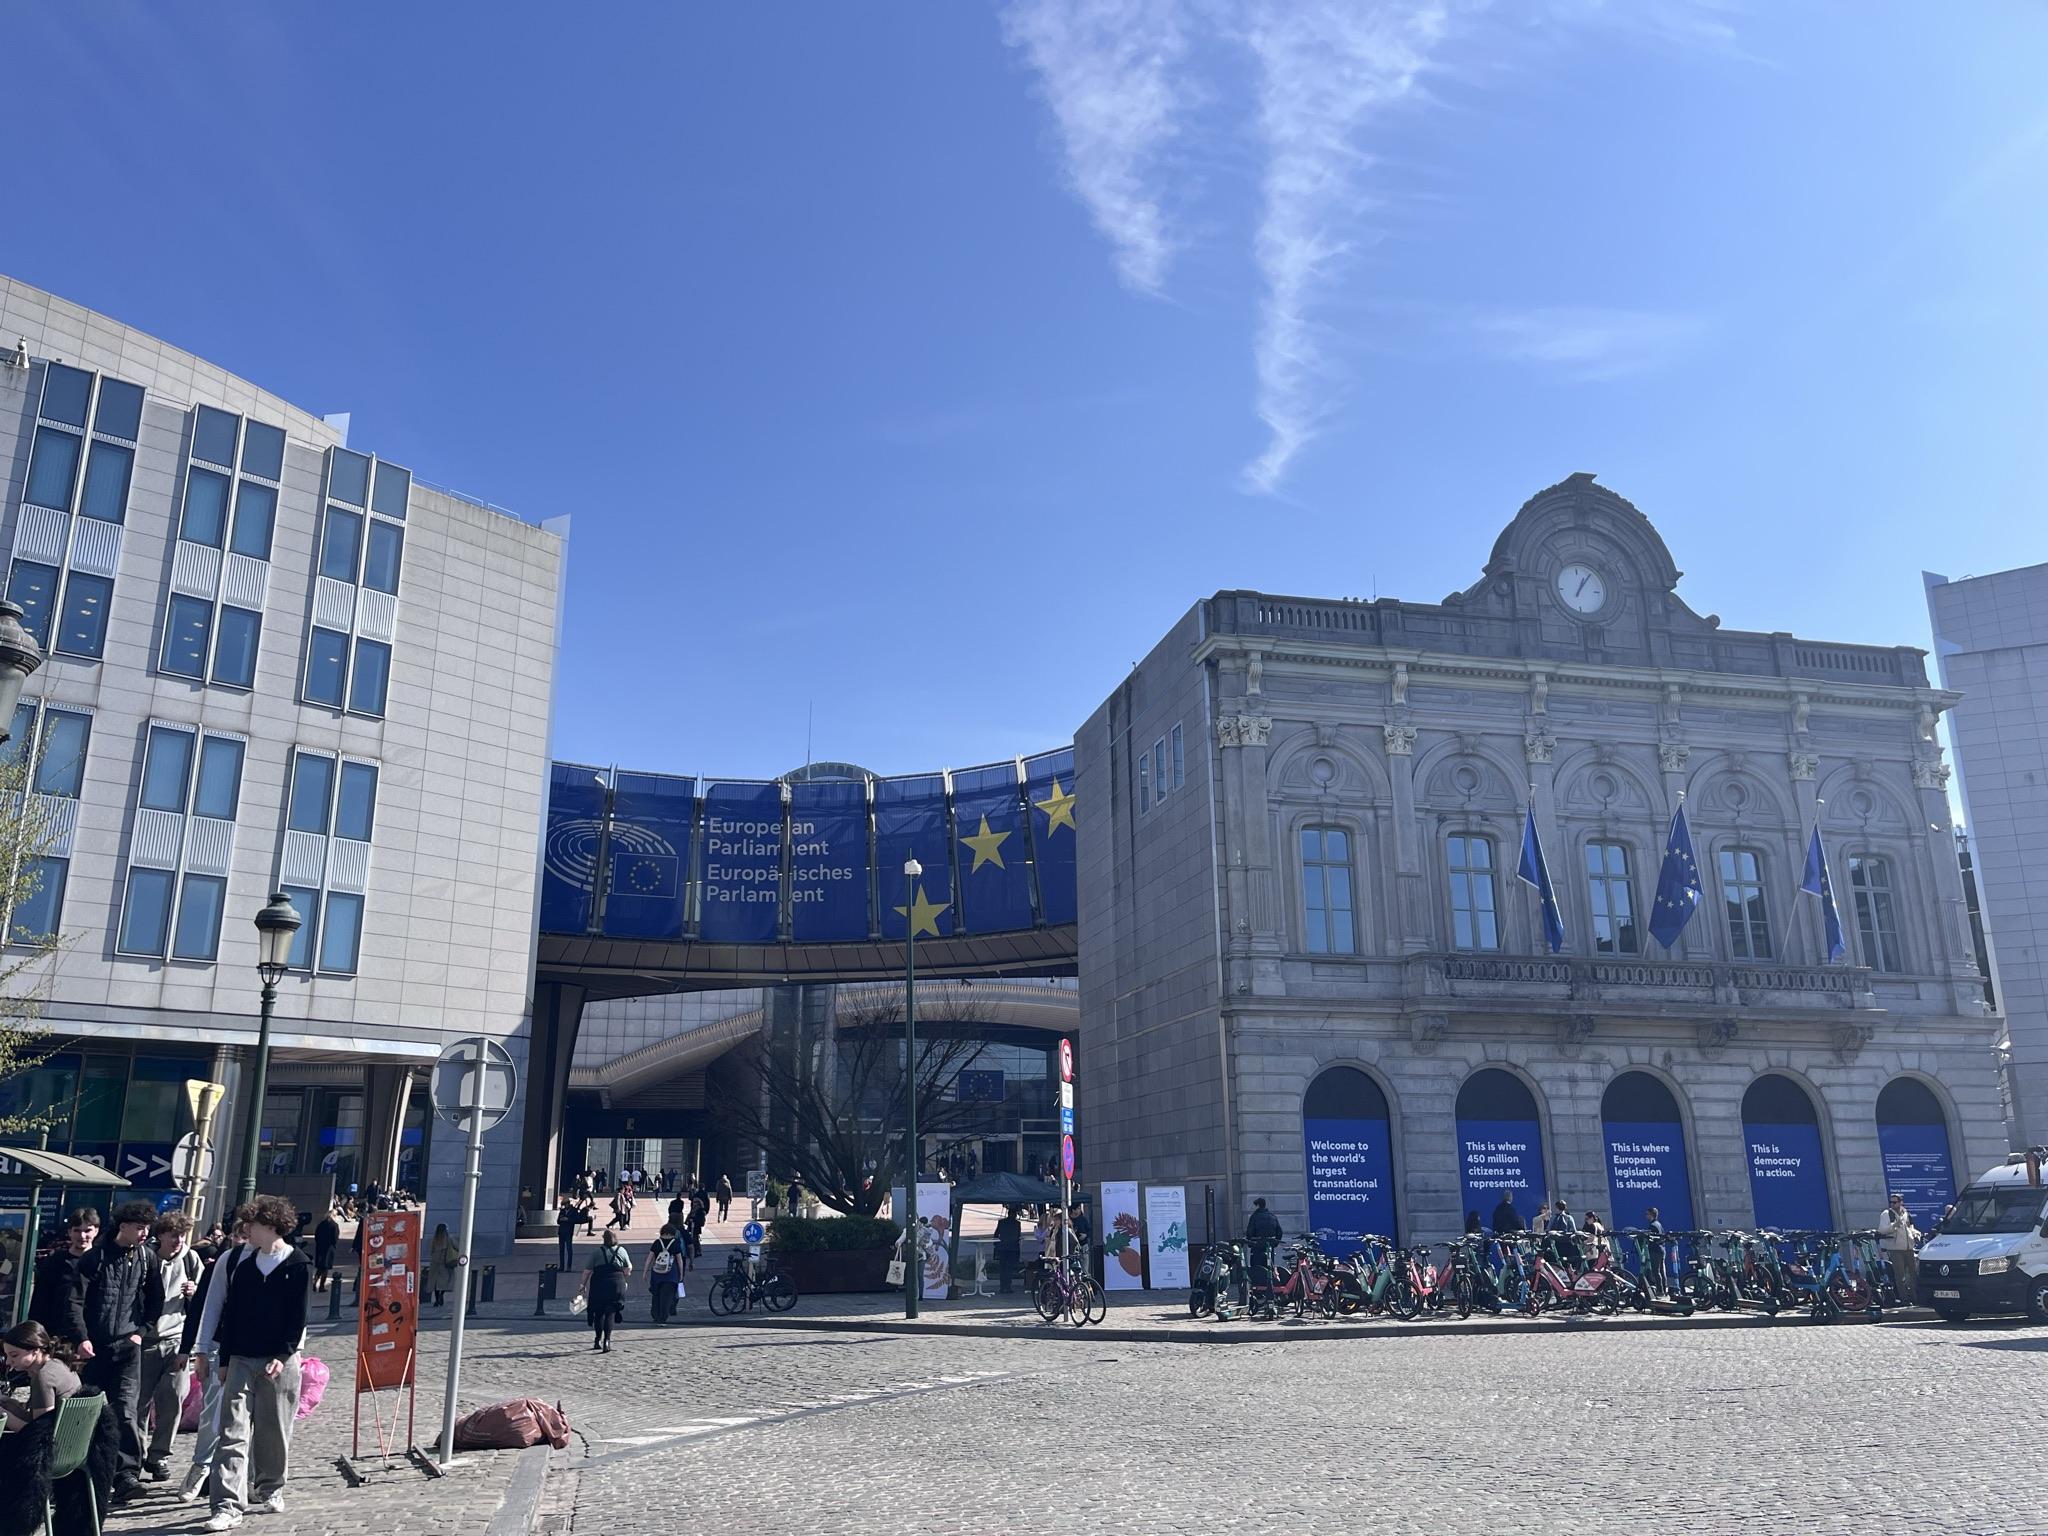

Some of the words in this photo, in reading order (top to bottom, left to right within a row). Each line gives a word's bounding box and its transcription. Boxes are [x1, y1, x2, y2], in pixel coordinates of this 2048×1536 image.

[709, 818, 815, 838] European
[708, 839, 829, 855] Parliament
[707, 864, 852, 884] Europäisches
[707, 885, 824, 902] Parlament
[1311, 1141, 1356, 1150] Welcome
[1358, 1142, 1368, 1150] to
[1466, 1142, 1486, 1151] This
[1488, 1142, 1495, 1151] is
[1498, 1142, 1526, 1151] where
[1611, 1143, 1631, 1152] This
[1633, 1144, 1640, 1152] is
[1642, 1144, 1670, 1152] where
[1752, 1144, 1771, 1153] This
[1772, 1145, 1779, 1153] is
[1312, 1154, 1328, 1163] the
[1331, 1154, 1365, 1163] world's
[1467, 1155, 1485, 1163] 450
[1488, 1154, 1519, 1163] million
[1613, 1156, 1656, 1166] European
[1754, 1157, 1800, 1167] democracy
[1312, 1166, 1346, 1177] largest
[1469, 1167, 1504, 1175] citizens
[1615, 1167, 1662, 1178] legislation
[1756, 1169, 1764, 1177] in
[1766, 1169, 1795, 1177] action.
[1313, 1179, 1377, 1188] transnational
[1470, 1179, 1528, 1189] represented.
[1617, 1180, 1624, 1188] is
[1626, 1180, 1661, 1190] shaped.
[1314, 1191, 1369, 1202] democracy.
